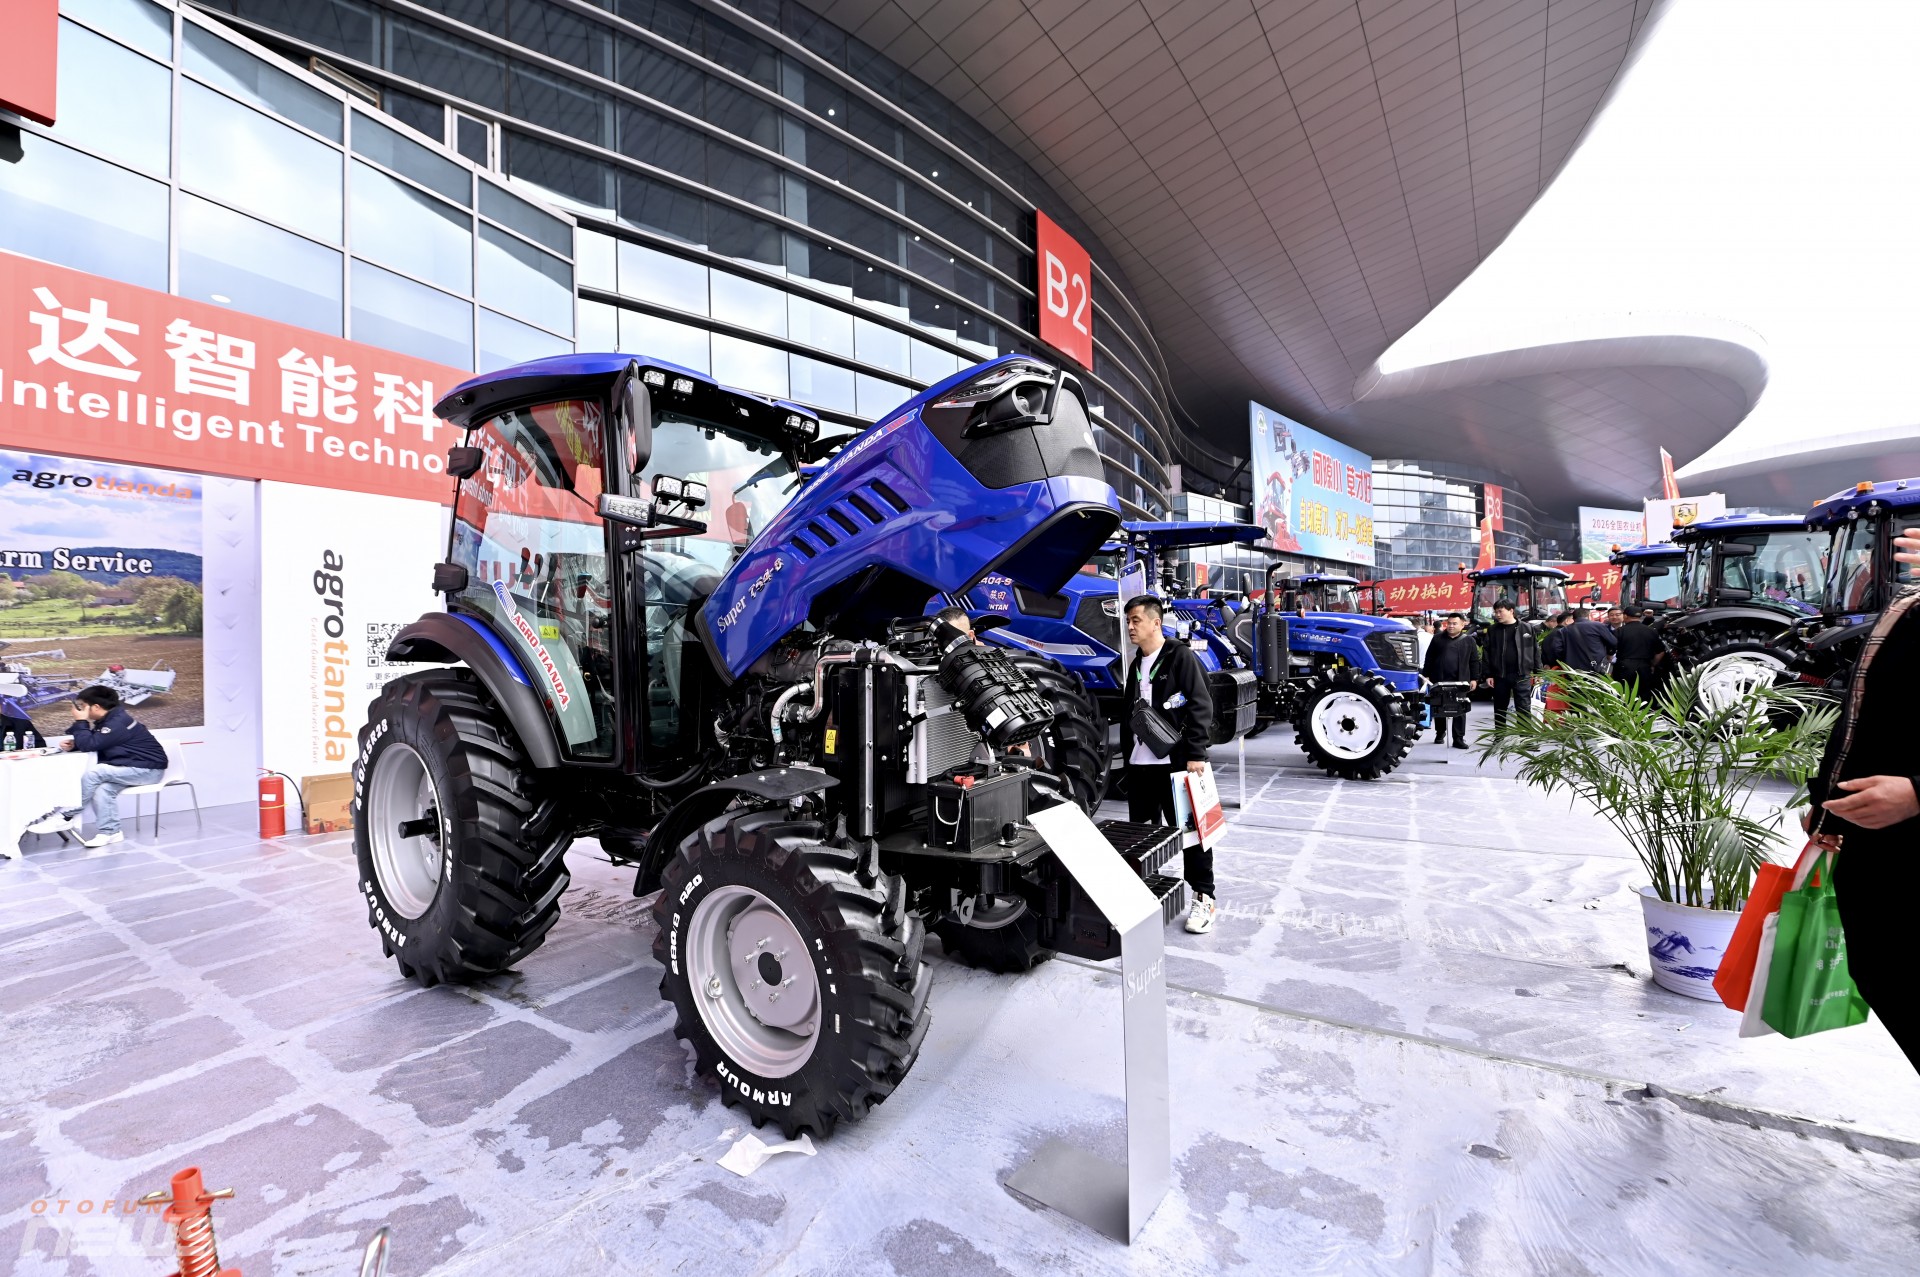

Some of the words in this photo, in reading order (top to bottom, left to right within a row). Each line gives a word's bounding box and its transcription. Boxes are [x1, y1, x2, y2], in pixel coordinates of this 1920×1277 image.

[1044, 249, 1088, 335] B2
[27, 286, 466, 447] 达智能科
[0, 368, 284, 449] ntelligent
[297, 423, 450, 474] Techno
[833, 428, 884, 472] TIANDA
[1312, 449, 1343, 494] 间隙小
[12, 469, 193, 499] agrotianda
[1486, 495, 1502, 520] B3
[0, 551, 43, 569] rm
[53, 547, 153, 574] Service
[979, 576, 1013, 586] 404-S
[1390, 581, 1454, 601] 动力换向
[717, 595, 747, 634] Super
[313, 549, 353, 762] agrotianda
[375, 671, 408, 681] 更多信
[514, 614, 540, 648] AGRO
[538, 647, 570, 705] TIANDA
[356, 718, 388, 811] 420/85R28
[680, 873, 703, 906] R20
[364, 879, 407, 948] ARMOUR
[1127, 955, 1163, 1002] Super
[716, 1060, 792, 1107] ARMOUR
